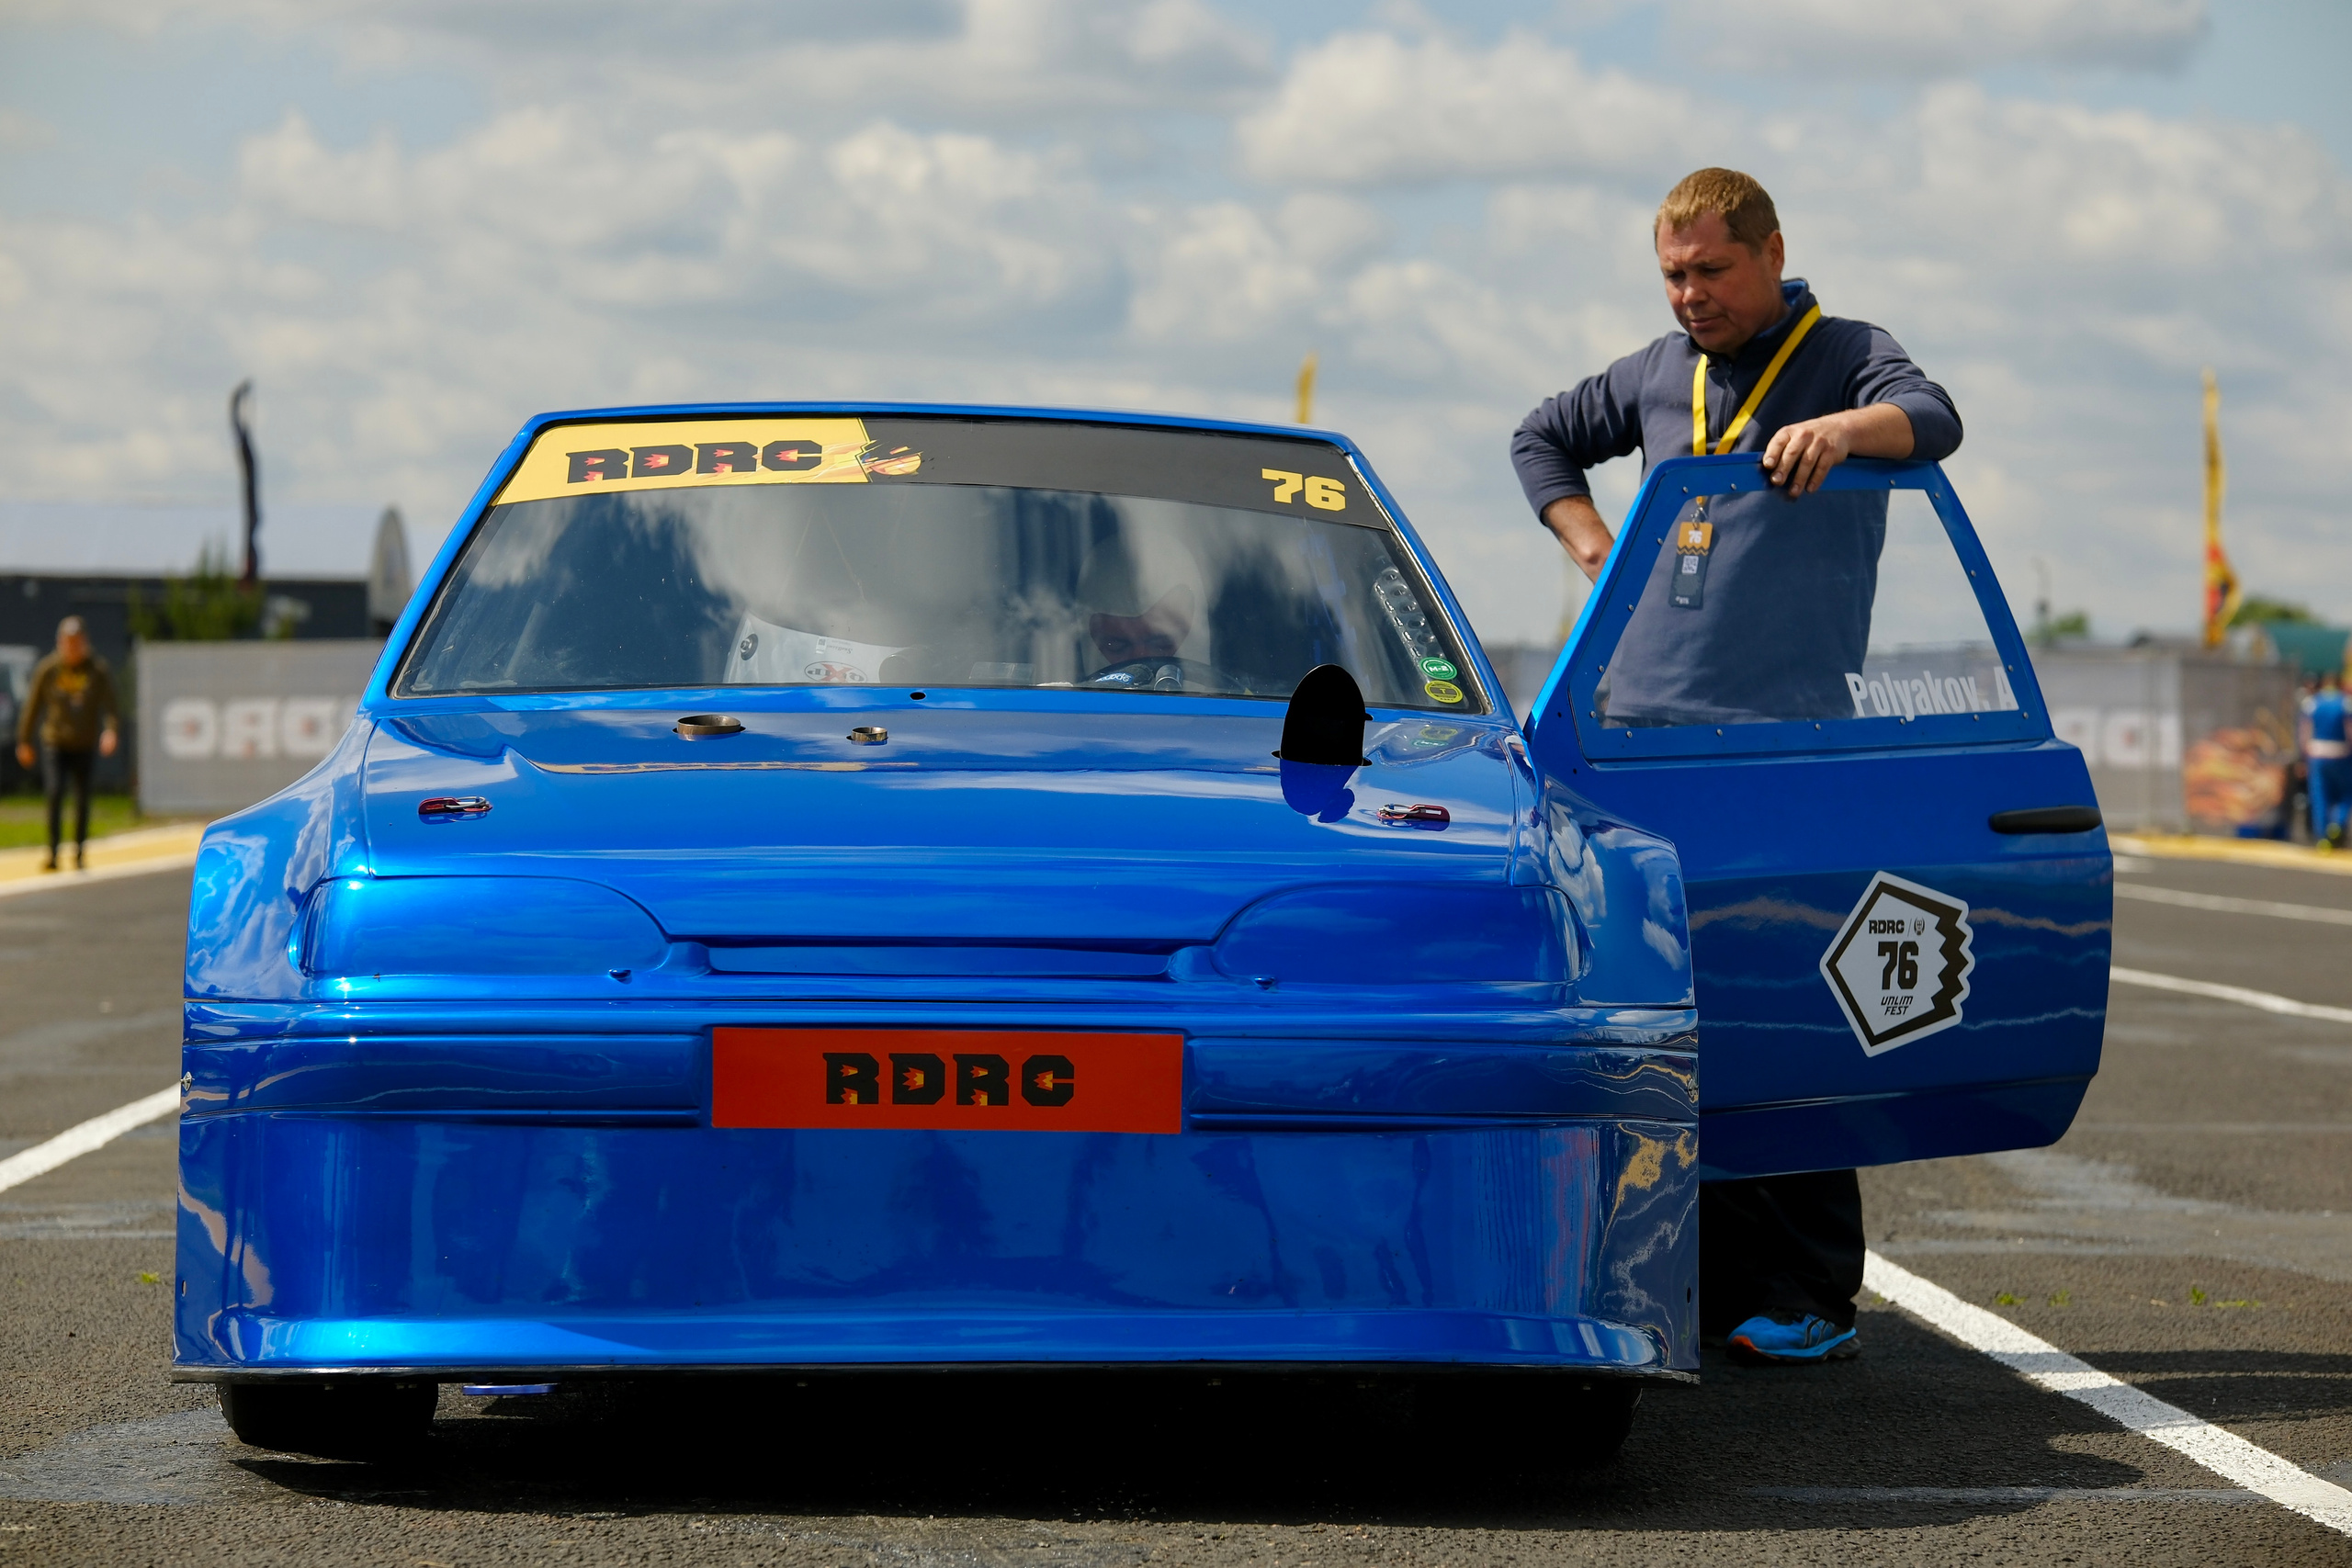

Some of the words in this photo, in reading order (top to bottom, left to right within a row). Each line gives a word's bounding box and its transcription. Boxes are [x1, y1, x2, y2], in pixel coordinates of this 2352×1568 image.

[566, 440, 822, 483] RDRC
[1261, 468, 1346, 512] 76
[1688, 530, 1702, 544] 76
[1993, 666, 2019, 711] A
[1869, 919, 1905, 934] RDRC
[1878, 941, 1919, 990] 76
[1884, 1006, 1909, 1016] FEST
[822, 1053, 1075, 1108] RDRC
